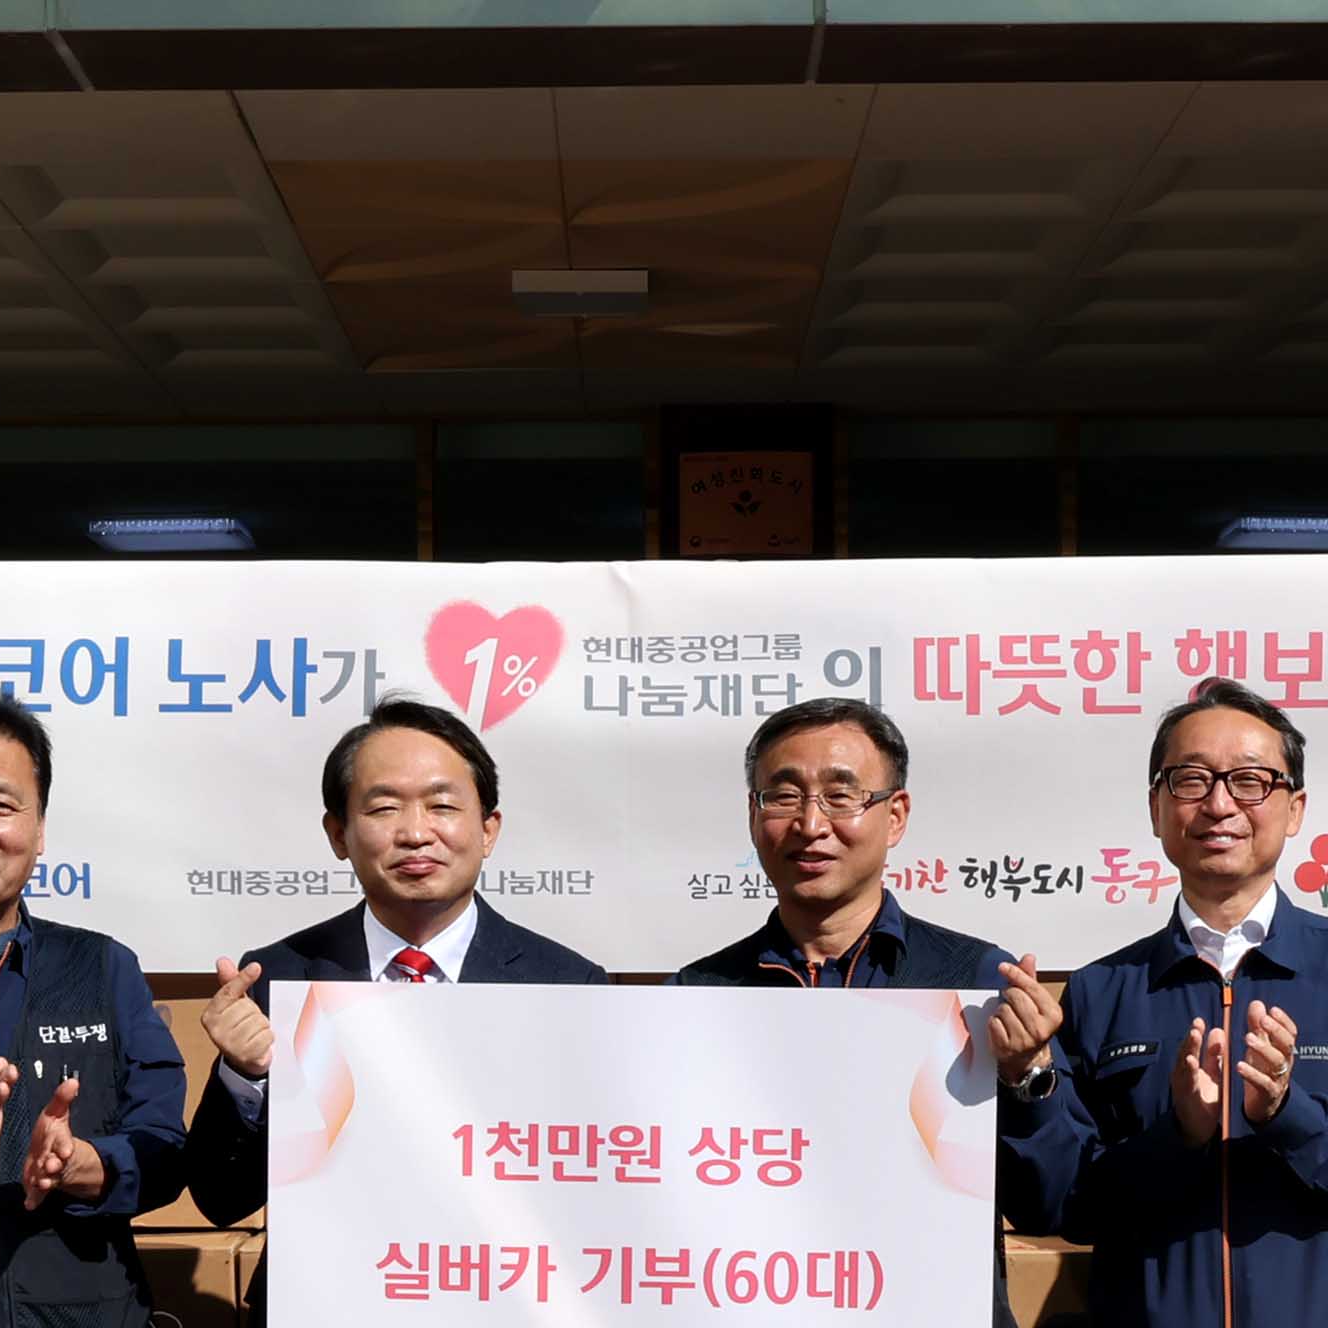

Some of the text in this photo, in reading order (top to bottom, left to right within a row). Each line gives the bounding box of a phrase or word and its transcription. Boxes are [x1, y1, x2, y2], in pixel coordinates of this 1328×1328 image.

[158, 637, 386, 717] 노사가
[582, 634, 803, 664] 현대중공업그룹
[823, 646, 883, 707] 의
[913, 630, 1152, 716] 따뜻한
[583, 672, 803, 717] 나눔재단
[186, 869, 594, 896] 현대중공업그 나눔재단
[687, 873, 733, 899] 살고
[881, 848, 1179, 904] 기찬 행복도시 동구
[452, 1121, 810, 1187] 1천만원 상당
[375, 1242, 884, 1309] 실버카 기부(60대)
